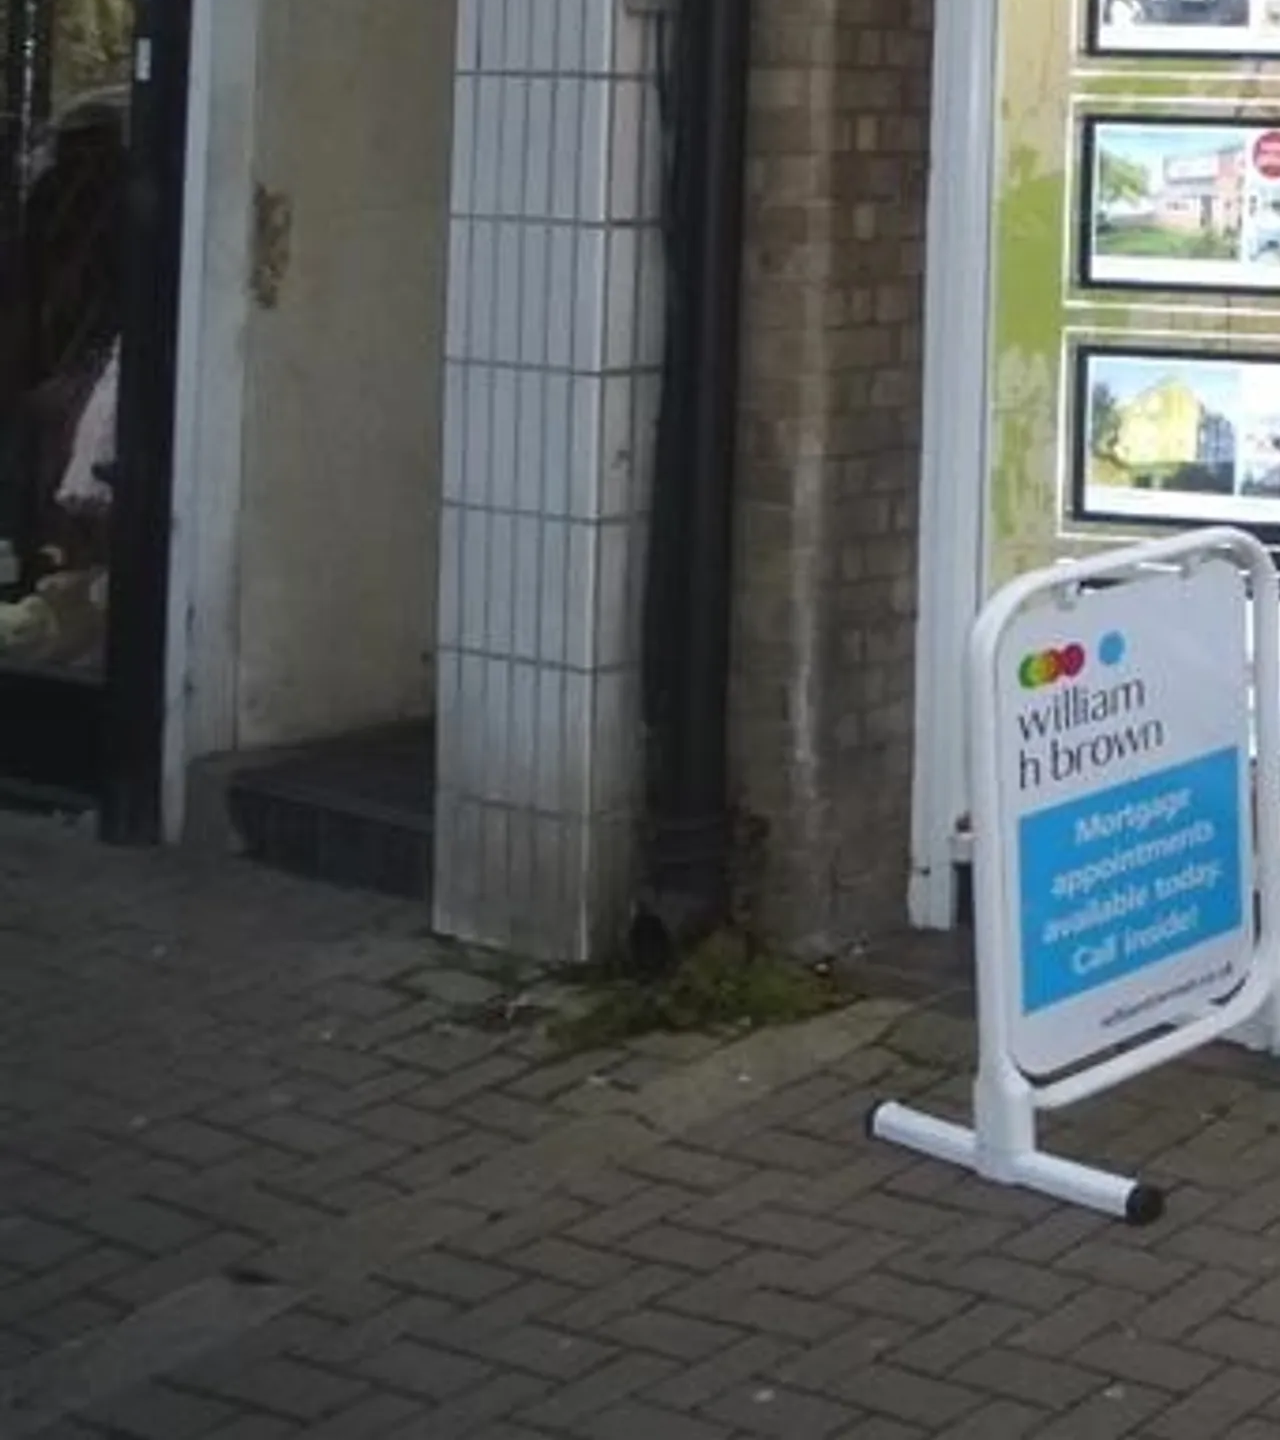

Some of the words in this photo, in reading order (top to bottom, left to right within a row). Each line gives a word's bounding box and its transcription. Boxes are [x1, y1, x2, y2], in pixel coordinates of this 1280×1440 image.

[1018, 679, 1146, 742] william
[1019, 749, 1041, 791] h
[1051, 719, 1164, 782] brown
[1074, 788, 1192, 848] Mortgage
[1051, 819, 1216, 900] appointments
[1041, 883, 1148, 945] available
[1072, 932, 1117, 975] Call
